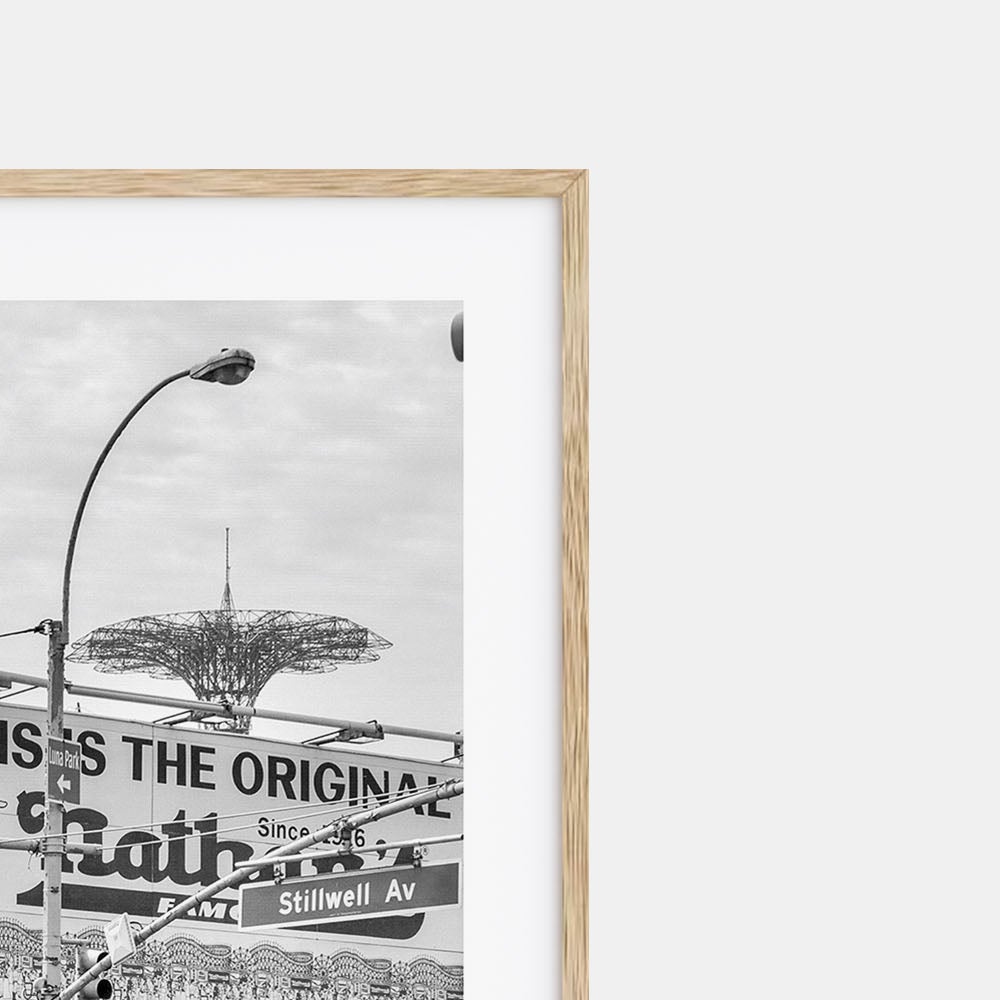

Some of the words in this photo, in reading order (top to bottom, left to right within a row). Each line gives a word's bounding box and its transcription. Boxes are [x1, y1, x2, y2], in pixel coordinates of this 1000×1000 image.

[63, 728, 106, 776] S
[122, 736, 216, 790] THE
[279, 882, 370, 915] Stillwell
[385, 879, 416, 903] Av
